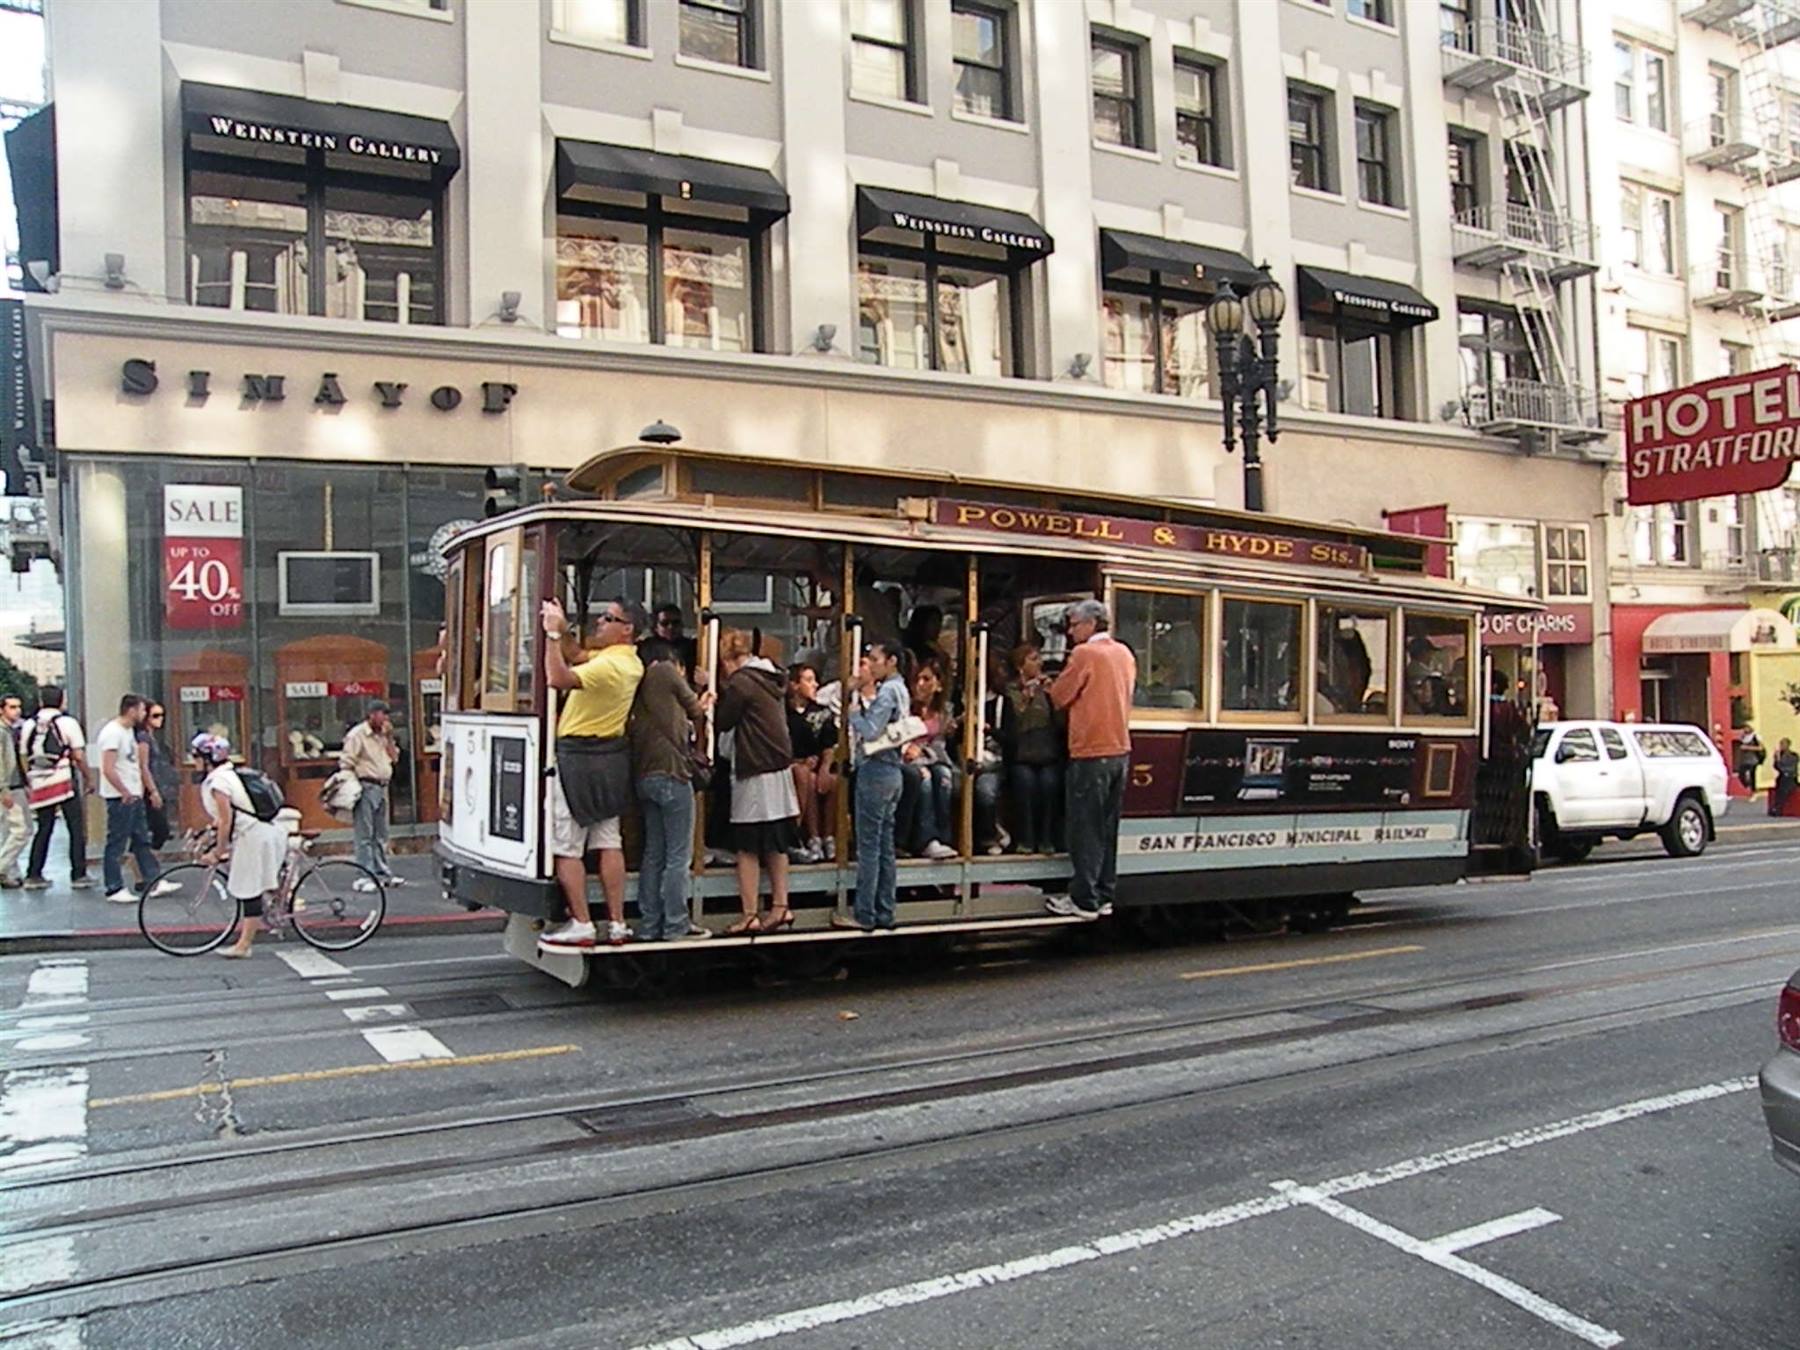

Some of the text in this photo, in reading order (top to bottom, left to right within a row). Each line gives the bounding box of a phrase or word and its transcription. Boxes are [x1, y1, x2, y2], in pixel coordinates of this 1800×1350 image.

[211, 116, 441, 164] WEINSTEIN GALLERY
[893, 213, 1042, 249] WEINSTEIN GALLERY
[122, 358, 518, 413] SIMAYOF
[1632, 373, 1800, 444] HOTEL
[168, 499, 239, 522] SALE
[957, 505, 1124, 540] POWELL
[1153, 526, 1177, 545] &
[1207, 532, 1294, 558] HYDE
[170, 546, 210, 558] UP TO
[210, 603, 240, 617] OFF
[1491, 614, 1513, 634] OF
[1516, 614, 1576, 633] CHARMS
[291, 684, 321, 696] SALE
[1133, 763, 1153, 786] 5
[1139, 826, 1429, 851] SAN FRANCISCO MUNICIPAL RAILWAY
